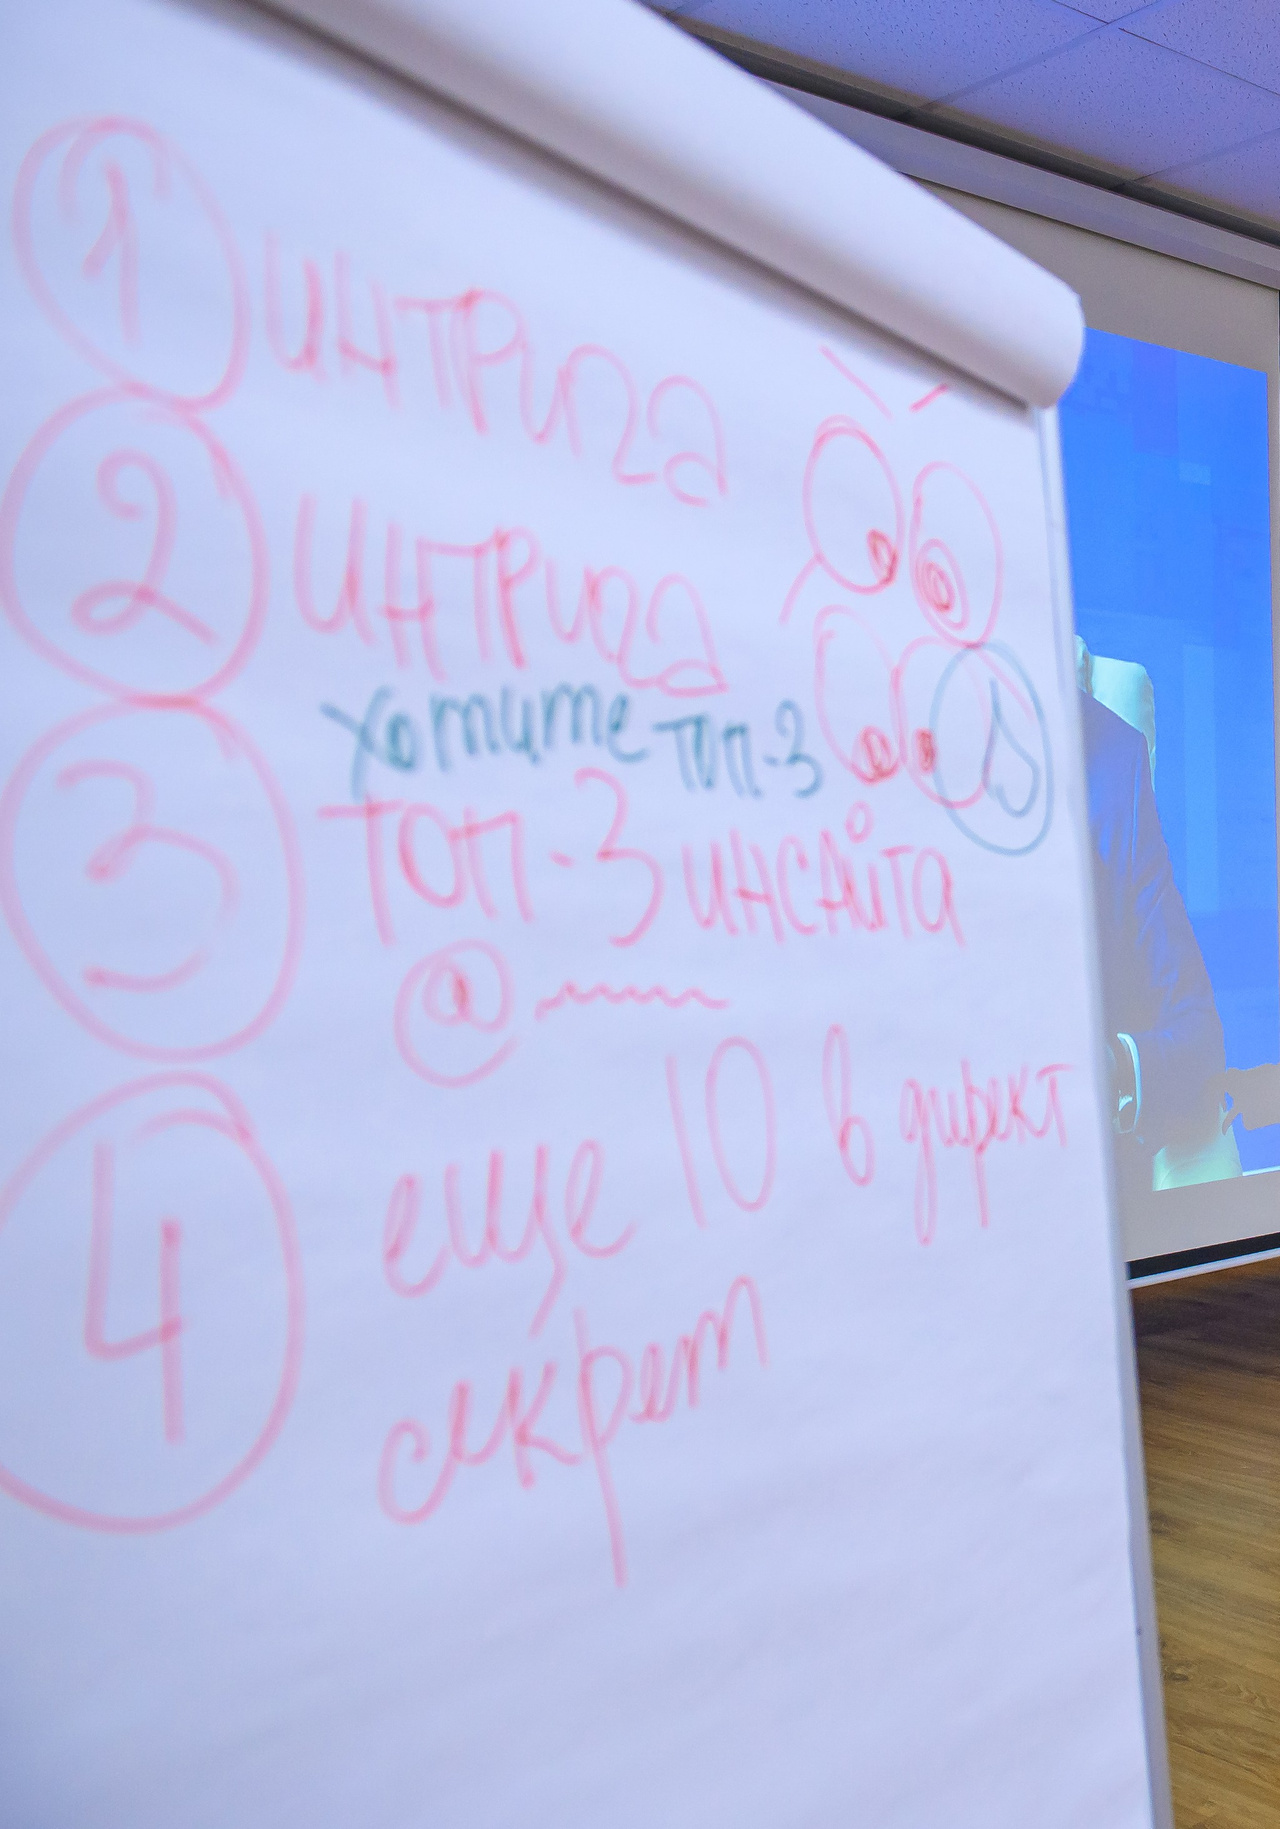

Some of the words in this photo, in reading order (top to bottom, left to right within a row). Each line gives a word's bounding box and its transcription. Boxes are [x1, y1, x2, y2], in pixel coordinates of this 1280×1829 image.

[70, 448, 220, 636] 2
[55, 757, 242, 994] 3
[84, 1138, 186, 1446] 4
[664, 1034, 777, 1230] 10
